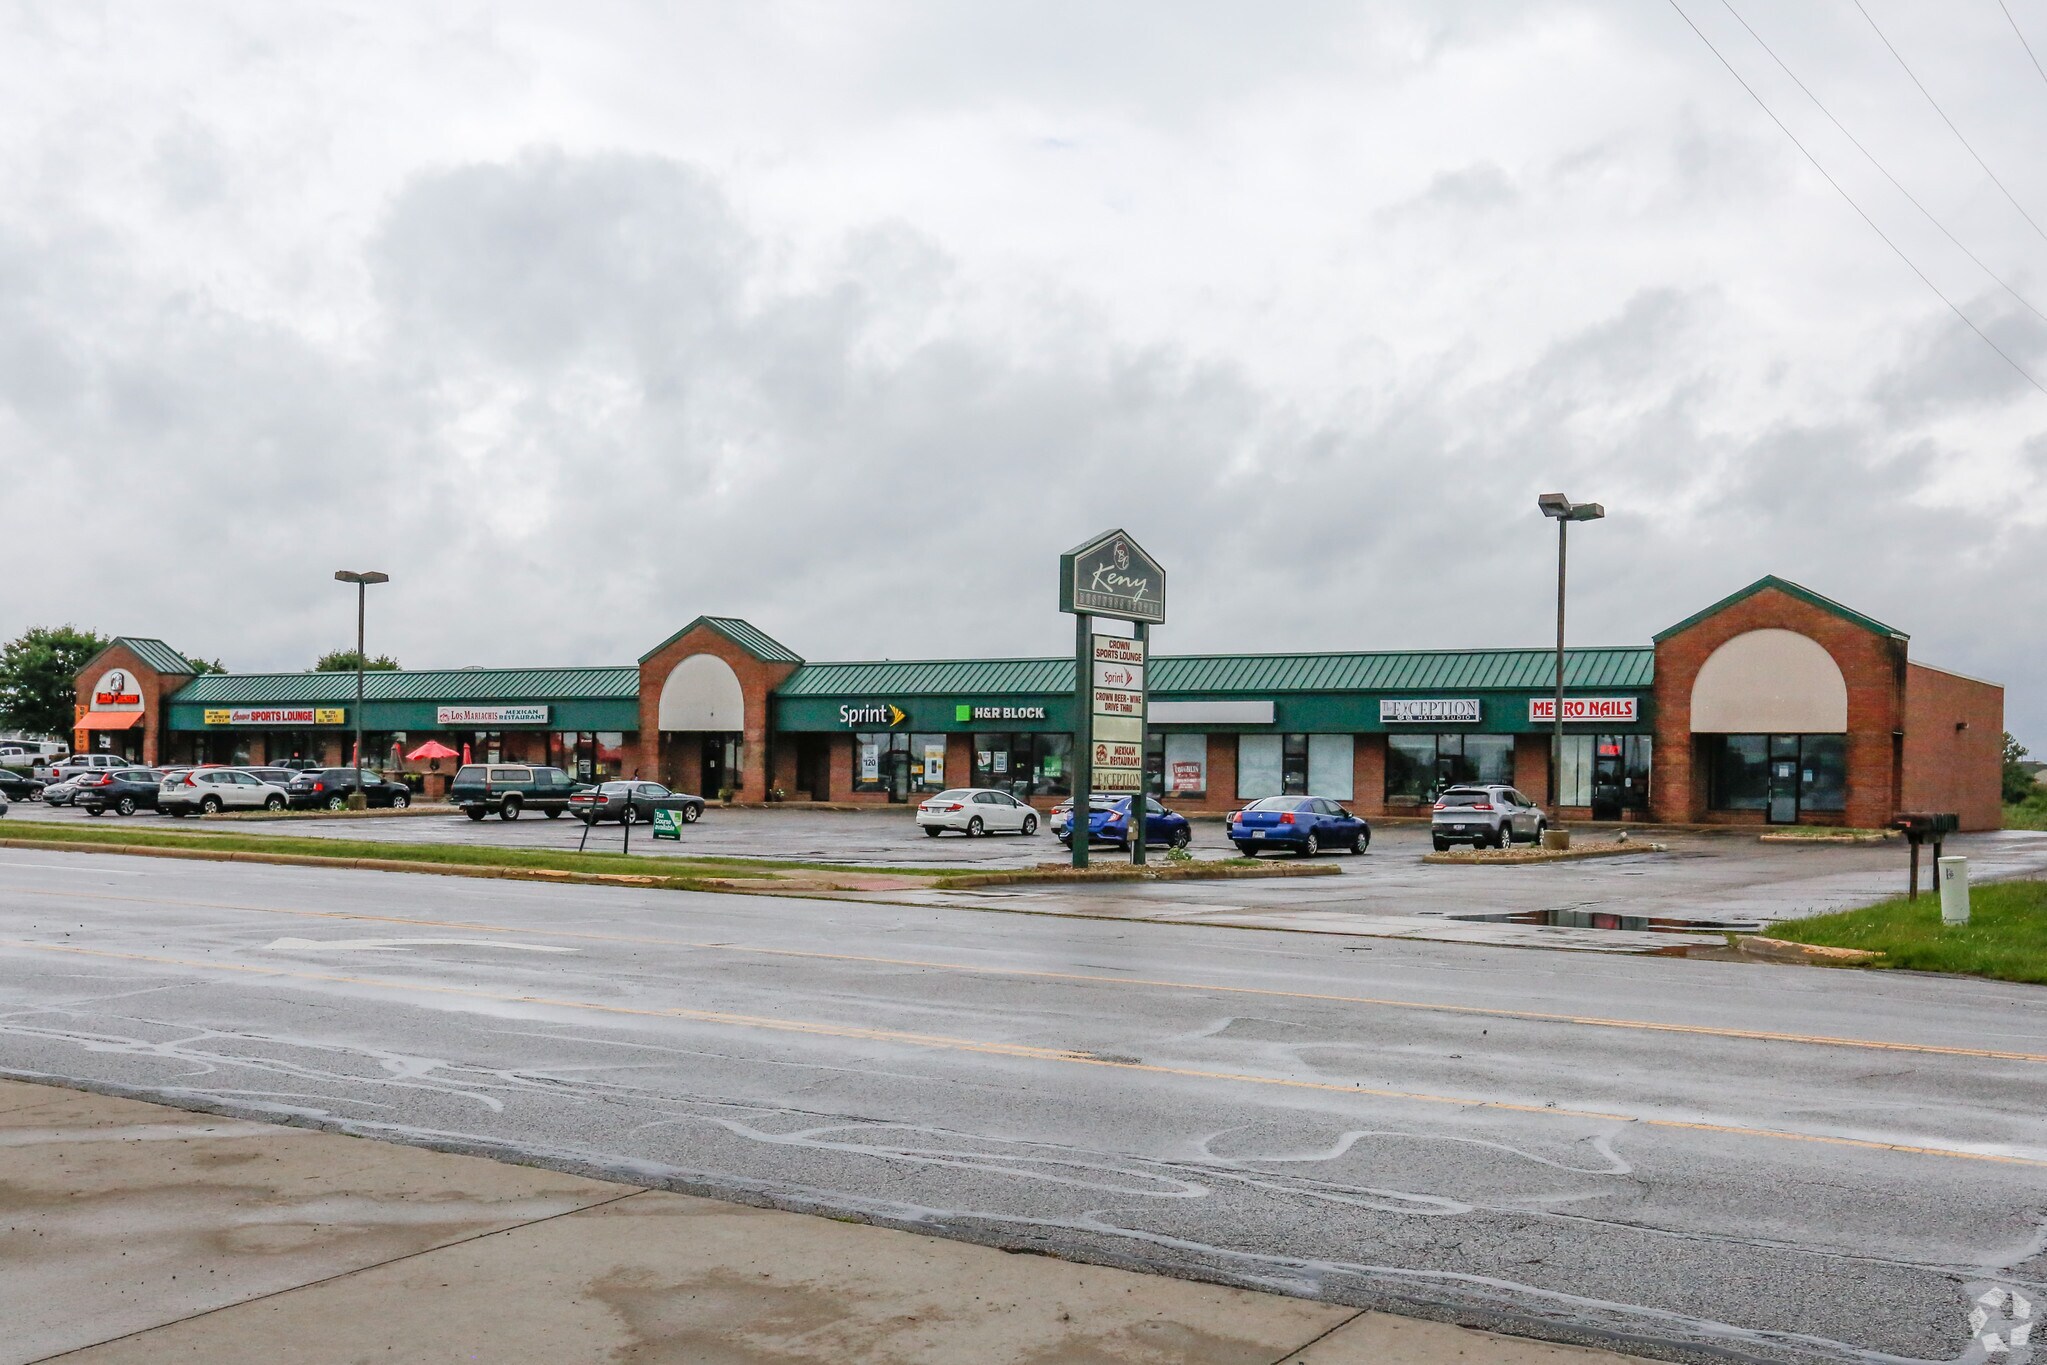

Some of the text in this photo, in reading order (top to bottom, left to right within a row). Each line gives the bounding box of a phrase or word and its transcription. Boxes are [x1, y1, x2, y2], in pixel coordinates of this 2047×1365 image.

[1092, 562, 1149, 602] Keny
[1109, 640, 1130, 650] CROWN
[1096, 648, 1142, 662] SPORTS LOUNGE
[1104, 671, 1124, 685] Sprint
[1095, 692, 1114, 702] CROWN
[1114, 693, 1127, 703] BEER
[1129, 695, 1142, 704] WINE
[974, 707, 1045, 719] H&R BLOCK
[1104, 702, 1132, 713] DRIVE THRU
[1589, 701, 1633, 716] NAILS
[251, 711, 281, 721] SPORTS
[282, 711, 313, 721] LOUNGE
[839, 704, 887, 728] Sprint
[1114, 746, 1136, 756] MEXICAN
[1109, 756, 1140, 766] RESTAURANT
[656, 811, 665, 819] Tax
